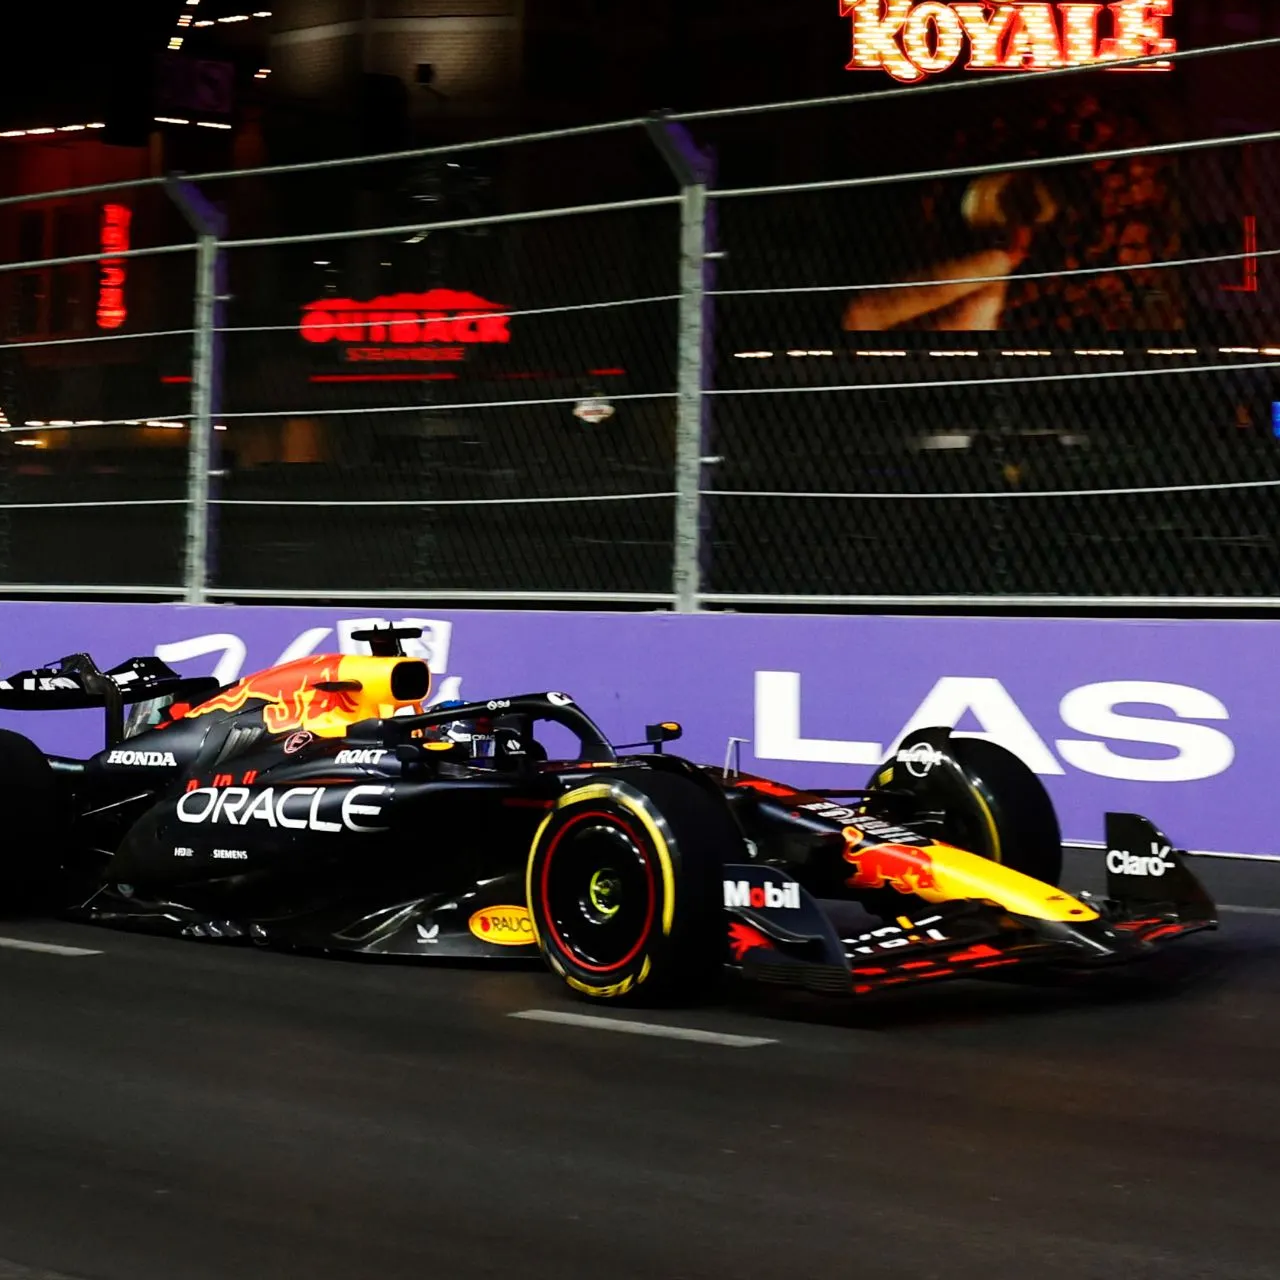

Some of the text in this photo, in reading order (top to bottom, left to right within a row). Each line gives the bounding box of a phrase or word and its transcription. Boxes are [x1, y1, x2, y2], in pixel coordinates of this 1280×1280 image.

[300, 311, 512, 344] OUTBACK
[753, 670, 1236, 782] LAS
[107, 750, 177, 767] HONDA
[334, 749, 388, 764] ROKT
[176, 785, 391, 833] ORACLE
[212, 848, 248, 860] SIEMENS
[1106, 849, 1166, 876] Claro
[723, 880, 800, 909] Mobil
[491, 916, 533, 933] RAUC
